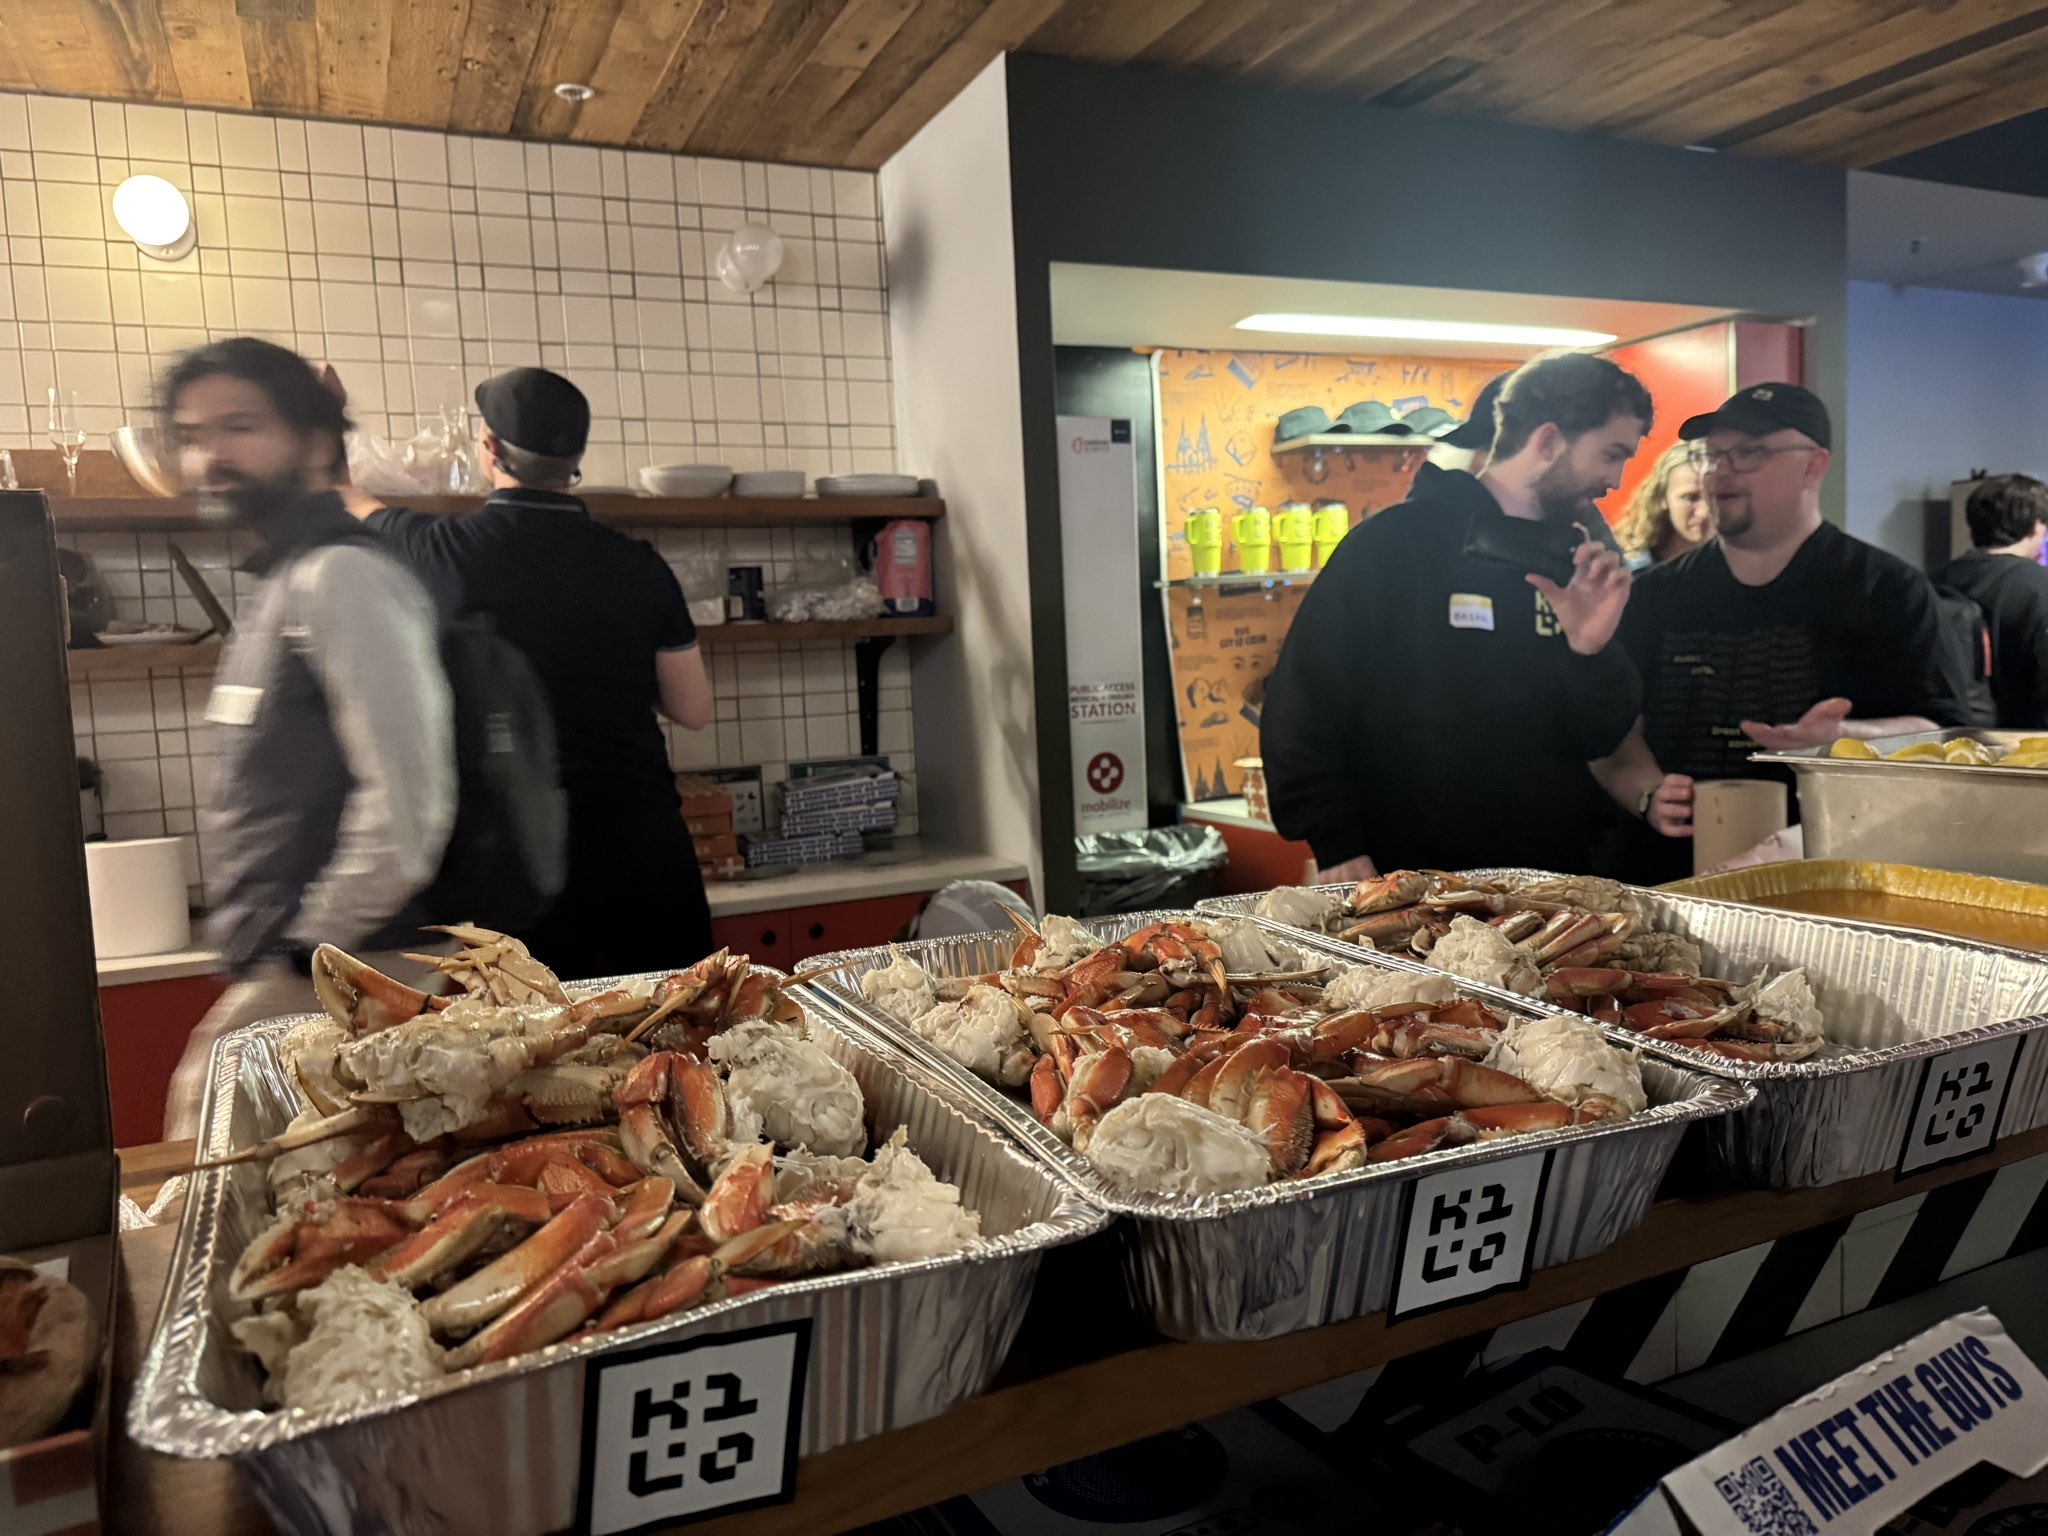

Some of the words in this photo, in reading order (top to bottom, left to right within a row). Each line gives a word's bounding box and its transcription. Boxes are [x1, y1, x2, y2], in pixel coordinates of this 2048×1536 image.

[1071, 702, 1136, 718] STATION
[1081, 798, 1131, 813] mobilize
[1774, 1408, 1897, 1521] MEET
[1855, 1375, 1957, 1466] THE
[1915, 1335, 2023, 1431] GUYS
